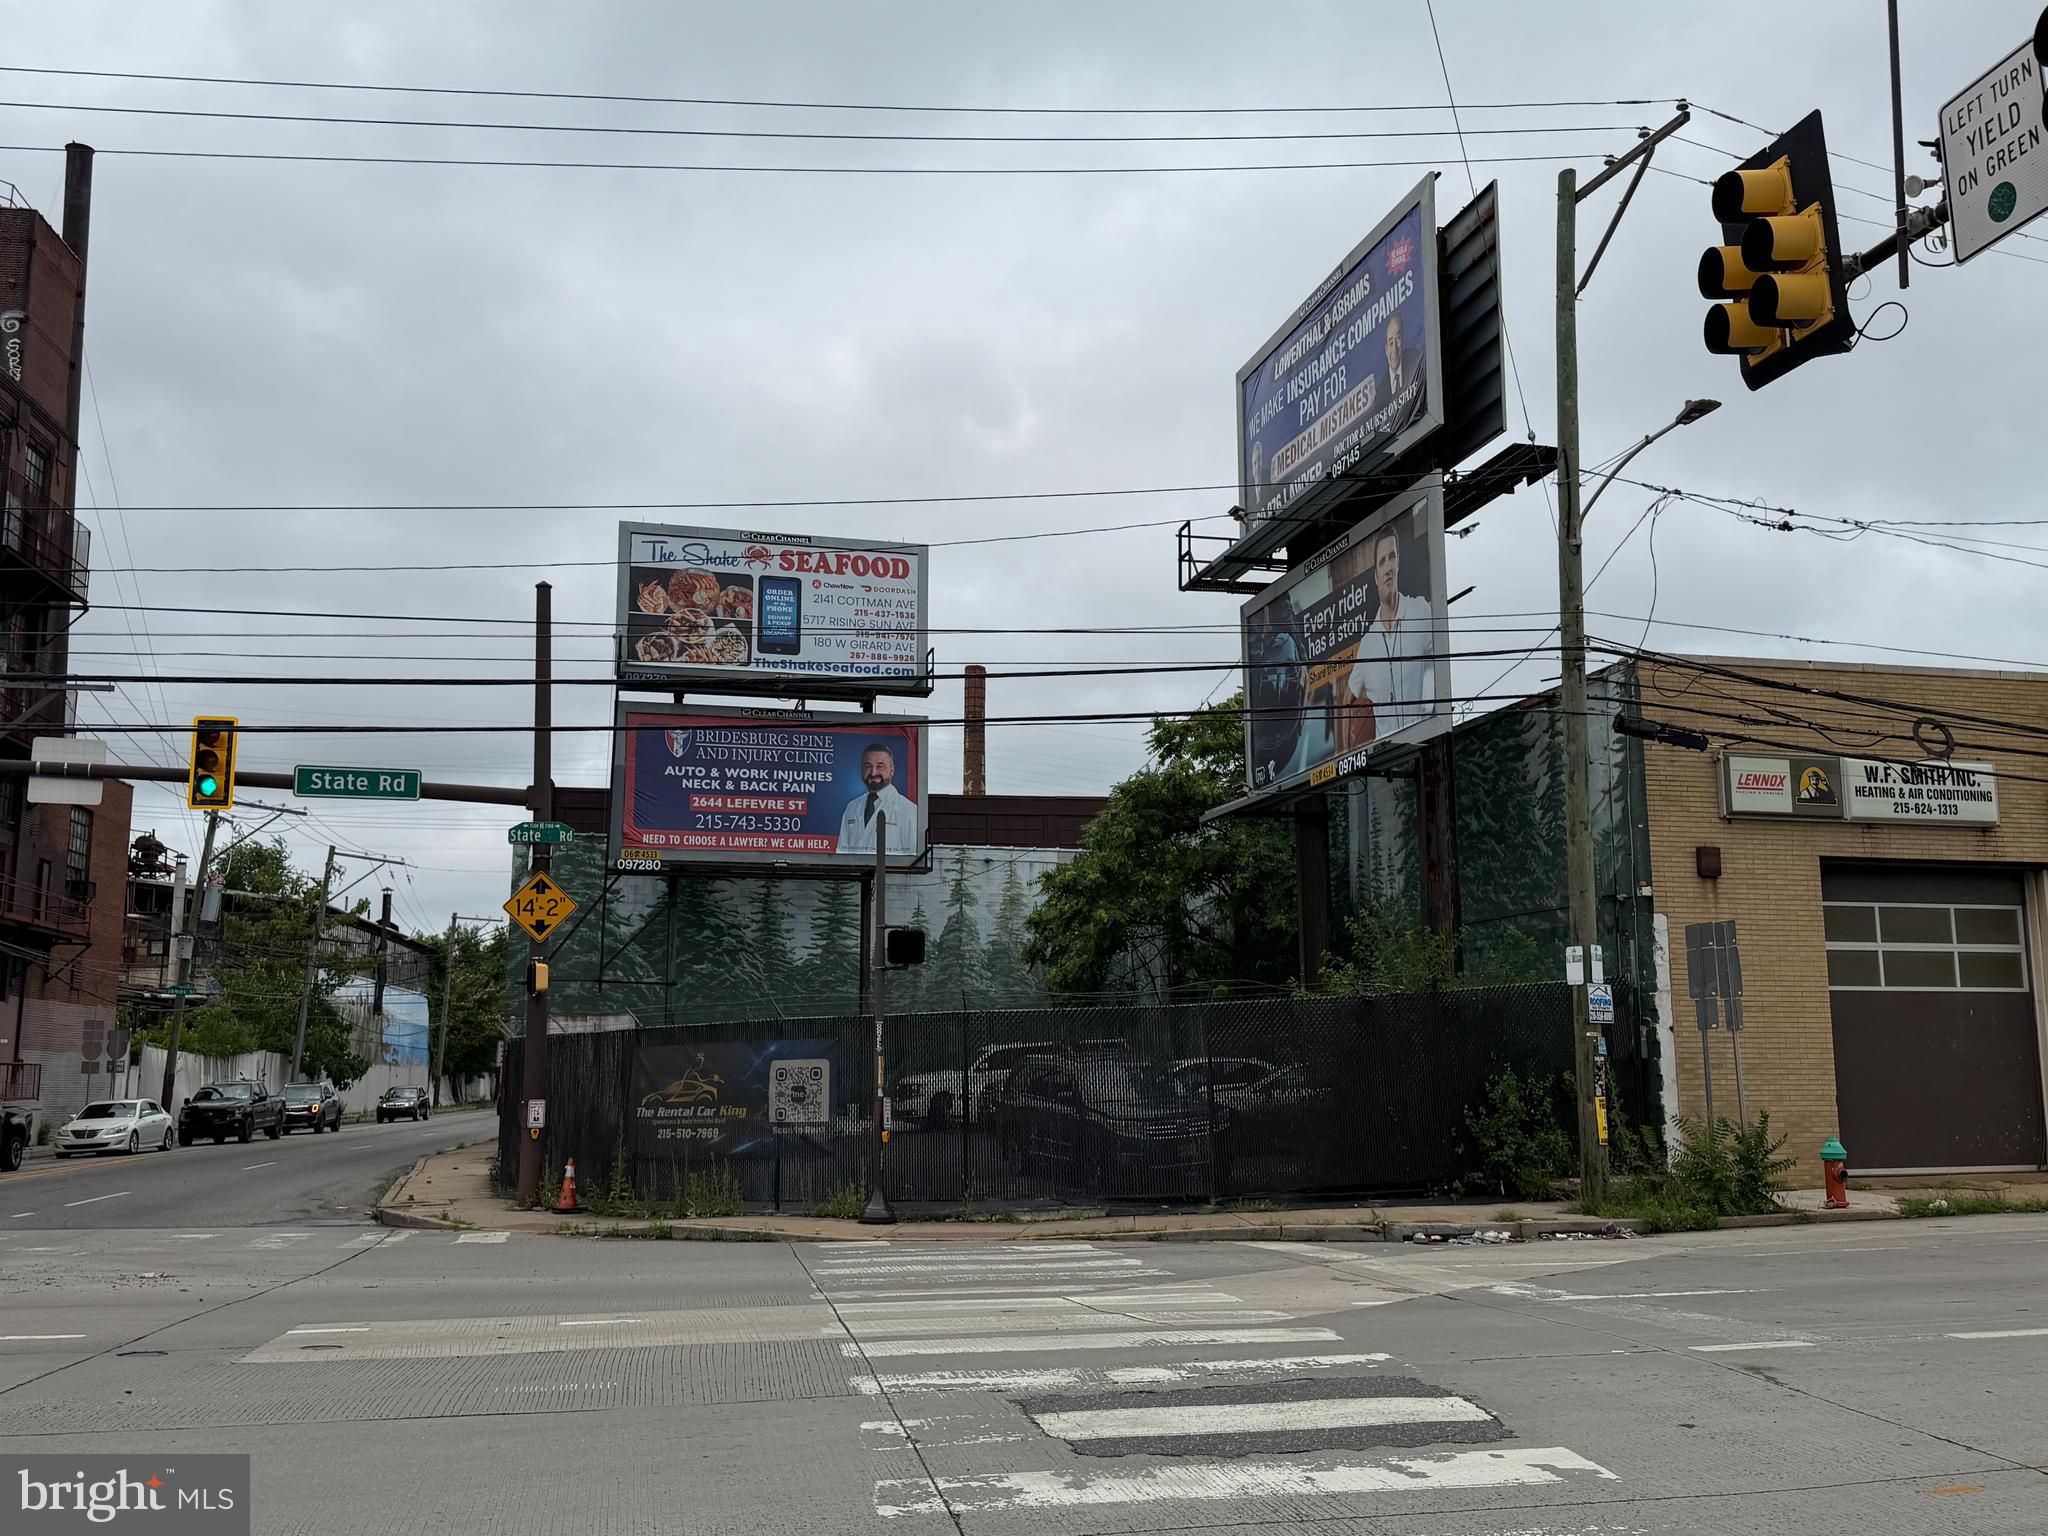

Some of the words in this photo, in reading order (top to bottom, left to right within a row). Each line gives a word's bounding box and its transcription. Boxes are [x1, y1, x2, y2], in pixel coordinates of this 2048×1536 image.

[1949, 93, 1983, 135] LEFT
[1990, 58, 2032, 103] TURN
[1966, 101, 2021, 157] YIELD
[1958, 168, 1978, 196] ON
[1986, 125, 2040, 177] GREEN
[1274, 327, 1324, 381] LOWENTHAL
[1324, 318, 1332, 335] &
[1332, 273, 1370, 328] ABRAMS
[1249, 413, 1261, 440] WE
[1261, 388, 1285, 427] MAKE
[1287, 336, 1346, 406] INSURANCE
[1348, 270, 1414, 350] COMPANIES
[1300, 389, 1321, 426] PAY
[1324, 365, 1347, 408] FOR
[1334, 429, 1359, 458] DOCTOR
[1366, 406, 1387, 434] NURSE
[1388, 399, 1399, 416] ON
[1399, 381, 1417, 409] STAFF
[1277, 422, 1319, 476] MEDICAL
[1320, 384, 1369, 442] MISTAKES
[1332, 445, 1360, 478] 097145
[641, 540, 677, 562] The
[682, 543, 741, 568] Shake
[779, 550, 910, 580] SEAFOOD
[823, 582, 855, 590] ChowNow
[874, 586, 916, 595] DOORDASH
[813, 594, 834, 604] 2141
[837, 596, 892, 609] COTTMAN
[895, 600, 916, 610] AVE
[1304, 601, 1337, 638] Every
[1338, 582, 1368, 616] rider
[803, 615, 826, 626] 5717
[829, 617, 866, 628] RISING
[869, 619, 892, 630] SUN
[895, 621, 915, 631] AVE
[854, 609, 916, 620] 215-437-1536
[813, 637, 832, 648] 180
[835, 639, 847, 649] W
[850, 639, 892, 650] GIRARD
[895, 642, 915, 652] AVE
[1308, 634, 1327, 659] has
[1327, 629, 1336, 649] a
[1337, 614, 1369, 644] story.
[850, 652, 915, 662] 267-886-9926
[753, 657, 915, 676] TheShakeSeafood.com
[1310, 669, 1326, 685] Share
[695, 730, 788, 746] BRIDESBURG
[792, 735, 834, 748] SPINE
[696, 748, 729, 760] AND
[732, 749, 780, 764] INJURY
[784, 751, 834, 764] CLINIC
[1338, 751, 1367, 776] 097146
[311, 772, 368, 791] State
[379, 774, 405, 792] Rd
[665, 766, 706, 777] AUTO
[711, 767, 720, 778] &
[725, 768, 769, 780] WORK
[773, 769, 833, 782] INJURIES
[1737, 774, 1786, 787] LENNOX
[1865, 765, 1896, 783] W.F.
[1900, 766, 1947, 786] SMITH
[1951, 768, 1981, 787] INC.
[682, 779, 720, 790] NECK
[725, 780, 735, 790] &
[740, 781, 778, 792] BACK
[783, 782, 816, 793] PAIN
[1854, 785, 1895, 799] HEATING
[1898, 788, 1906, 798] &
[1908, 788, 1924, 800] AIR
[1926, 789, 1993, 803] CONDITIONING
[692, 797, 722, 808] 2644
[727, 798, 784, 810] LEFEVRE
[788, 800, 806, 810] ST
[1893, 802, 1958, 815] 215-624-1313
[695, 814, 801, 832] 215-743-5330
[510, 829, 541, 842] State
[560, 830, 573, 842] Rd
[643, 834, 665, 844] NEED
[669, 835, 680, 845] TO
[684, 835, 717, 846] CHOOSE
[720, 836, 726, 845] A
[729, 836, 768, 847] LAWYER?
[771, 838, 784, 848] WE
[787, 838, 804, 849] CAN
[807, 839, 830, 849] HELP.
[617, 859, 661, 870] 097280
[636, 1107, 655, 1118] The
[657, 1105, 694, 1118] Rental
[697, 1105, 717, 1117] Car
[719, 1105, 748, 1119] King
